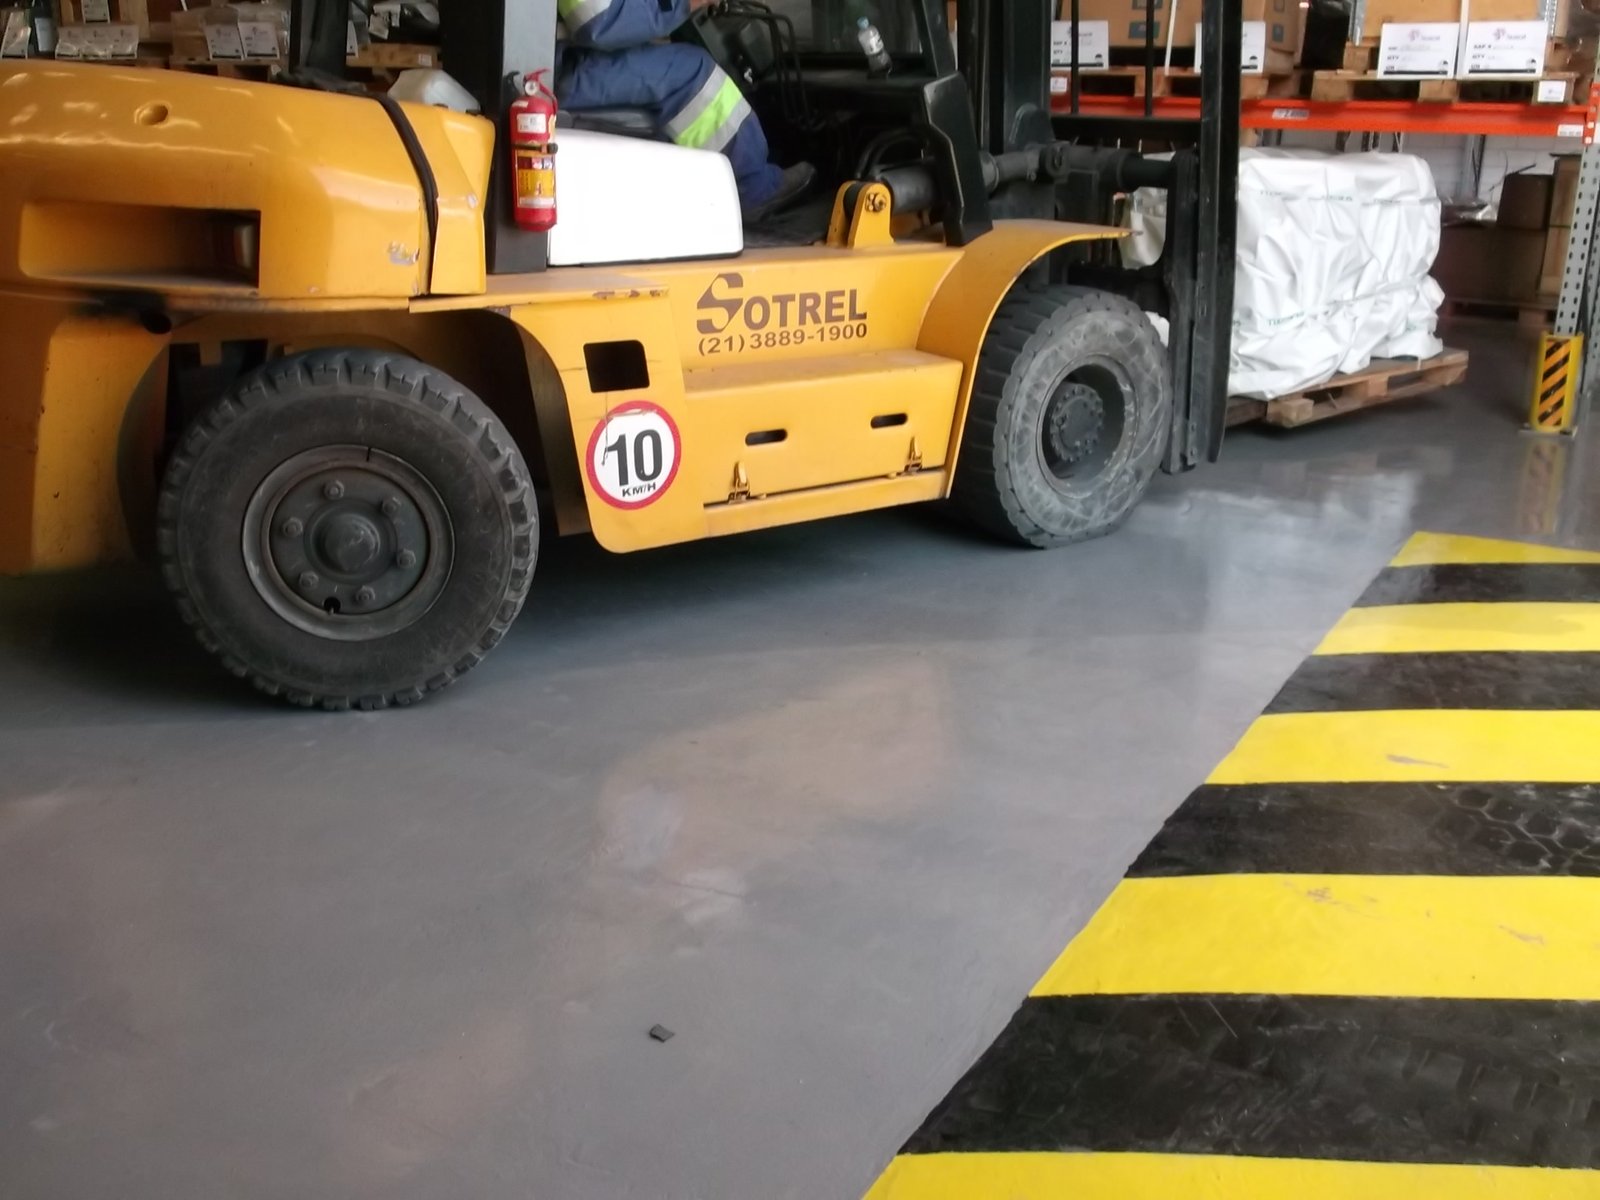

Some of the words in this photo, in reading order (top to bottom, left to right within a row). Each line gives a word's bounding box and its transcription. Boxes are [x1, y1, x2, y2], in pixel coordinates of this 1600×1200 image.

[697, 272, 867, 335] SOTREL
[605, 429, 662, 487] 10
[622, 482, 656, 497] KM/H
